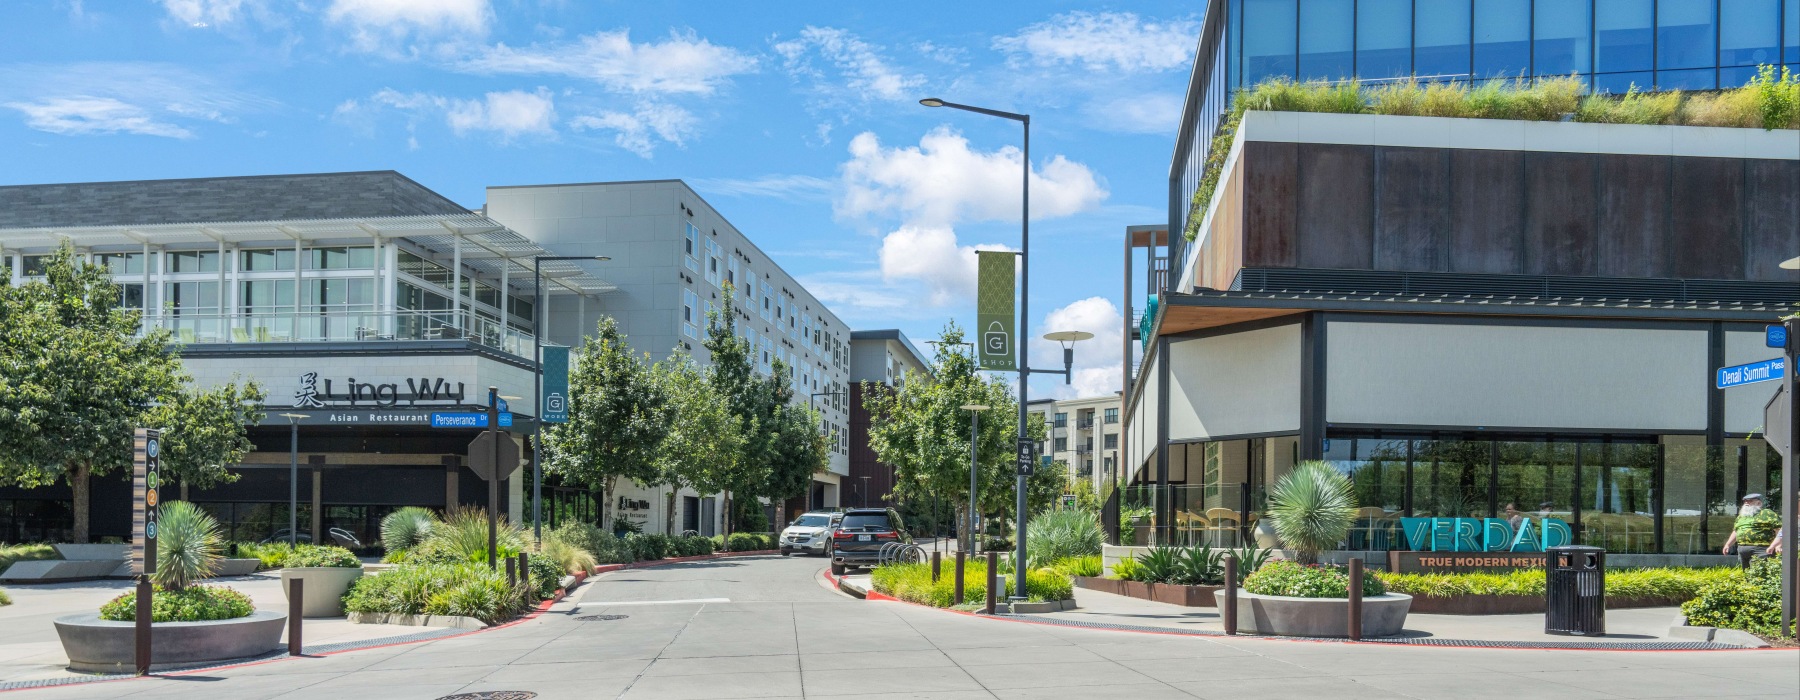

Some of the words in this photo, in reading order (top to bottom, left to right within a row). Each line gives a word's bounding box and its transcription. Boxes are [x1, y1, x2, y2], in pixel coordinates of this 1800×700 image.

[990, 337, 1003, 349] G
[1722, 368, 1741, 384] Denali
[1743, 364, 1769, 381] Summit
[1771, 362, 1784, 370] Pass
[324, 377, 398, 407] Ling
[406, 377, 465, 401] Wu
[550, 399, 560, 409] G
[330, 413, 358, 422] Asian
[369, 413, 428, 422] Restaurant
[435, 414, 476, 426] Perseverance
[1400, 517, 1572, 552] VERDAD
[1419, 557, 1452, 567] TRUE
[1455, 557, 1509, 567] MODERN
